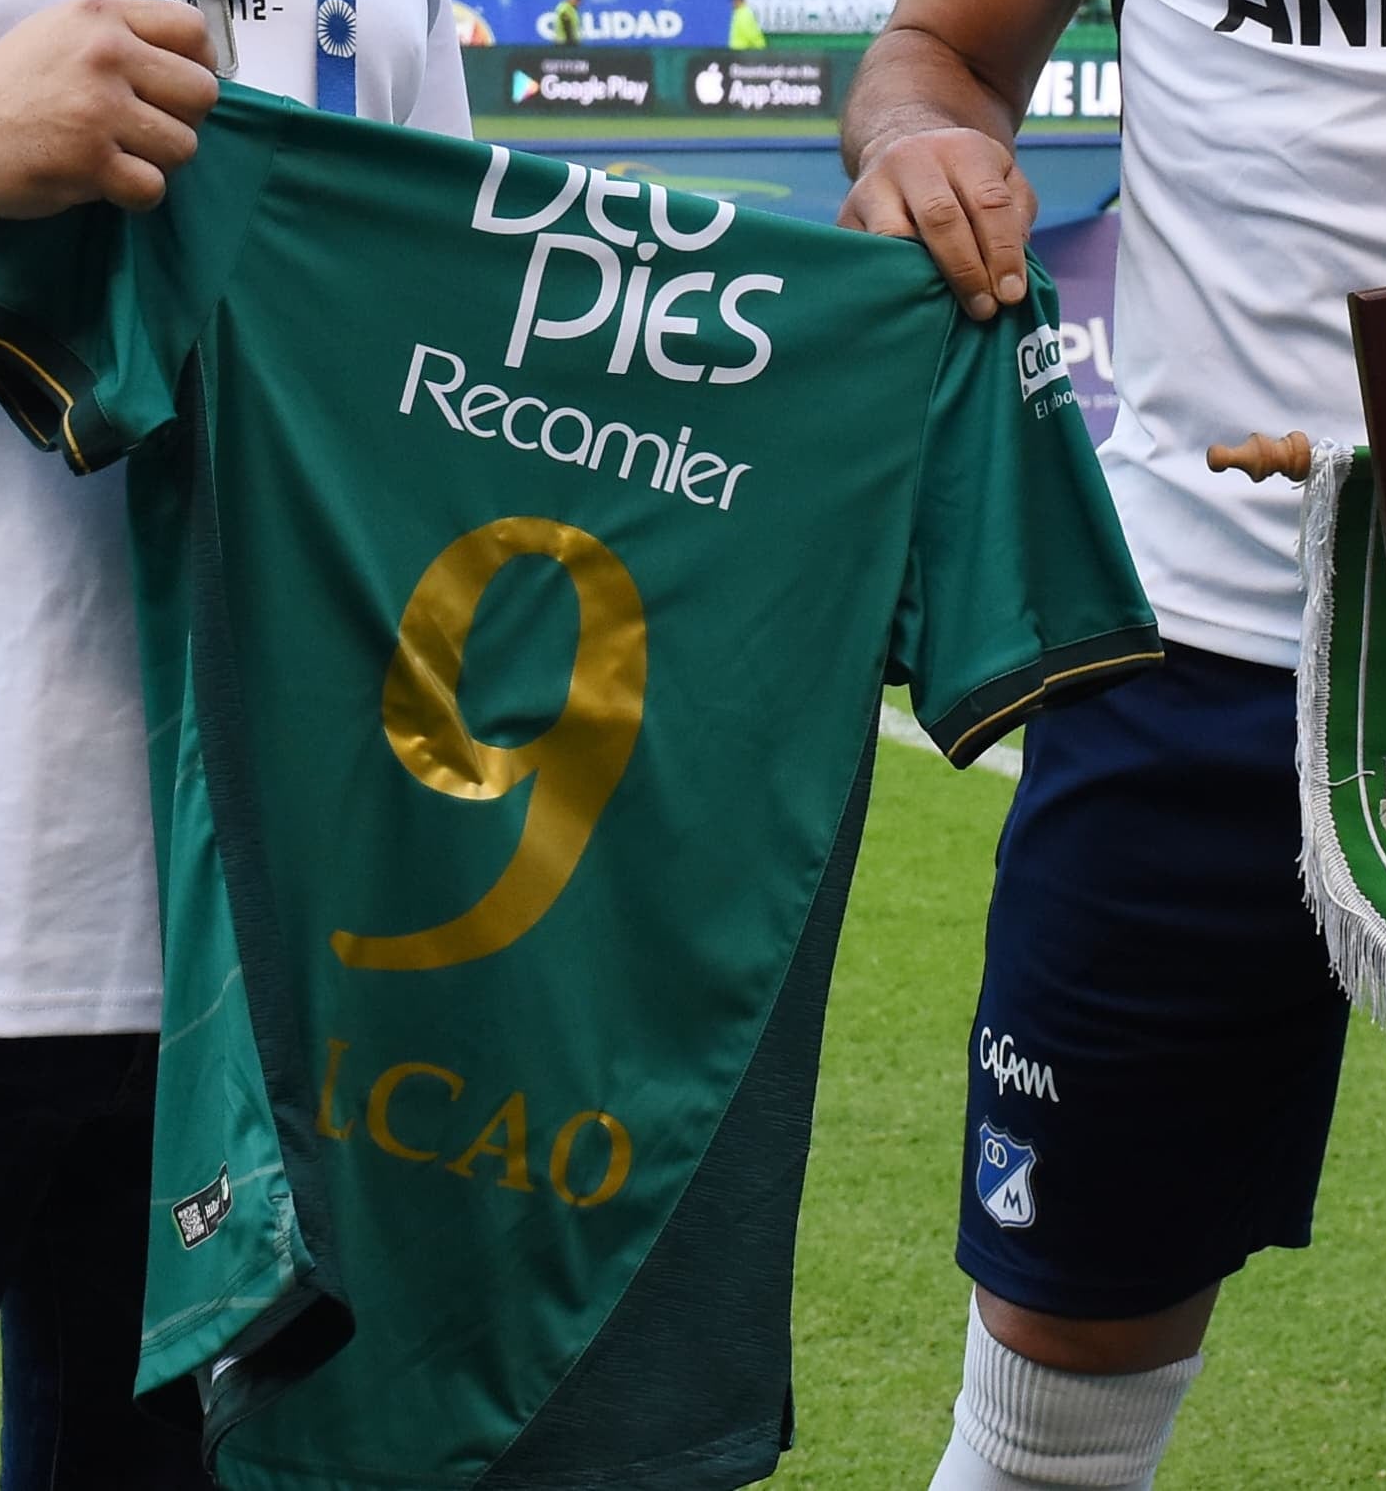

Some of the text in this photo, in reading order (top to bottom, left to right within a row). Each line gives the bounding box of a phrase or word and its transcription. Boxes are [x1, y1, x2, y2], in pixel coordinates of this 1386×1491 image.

[536, 10, 684, 40] CLIDAD
[540, 76, 648, 105] Google Play
[729, 80, 822, 109] App Store
[398, 343, 752, 511] Recamier
[330, 516, 648, 971] 9
[316, 1038, 634, 1209] LCAO
[1003, 1186, 1023, 1216] M
